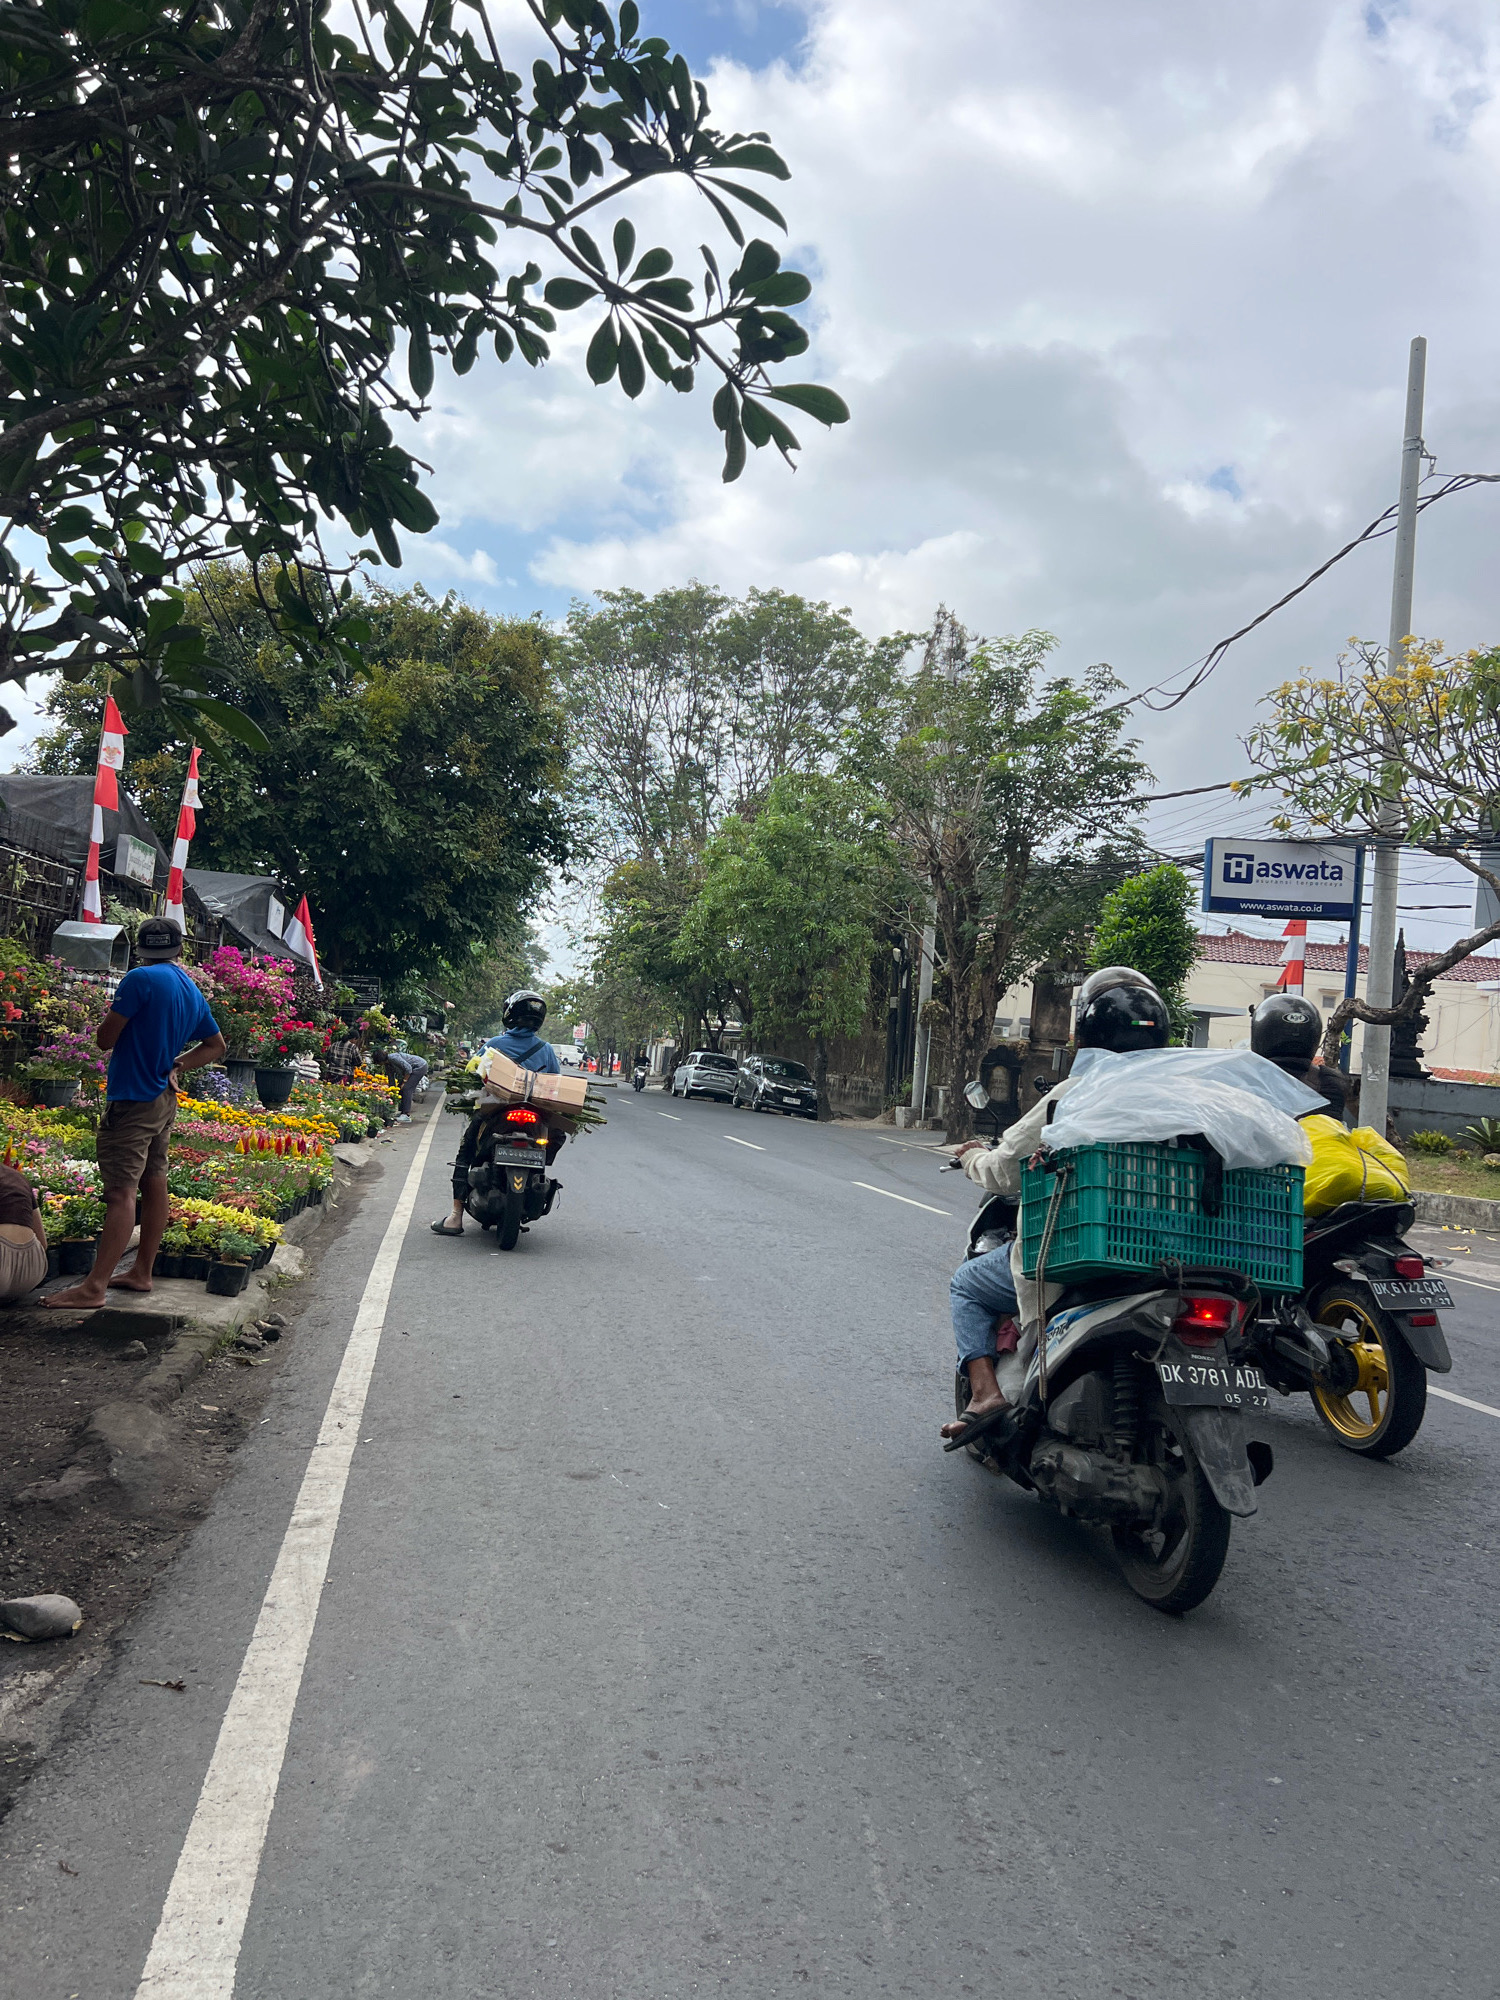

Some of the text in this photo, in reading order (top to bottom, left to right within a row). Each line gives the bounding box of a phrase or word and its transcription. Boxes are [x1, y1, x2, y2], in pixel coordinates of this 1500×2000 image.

[1256, 860, 1343, 881] aswata
[1239, 902, 1323, 913] www.aswata.co.id
[1372, 1282, 1390, 1295] DK
[1160, 1364, 1267, 1389] DK 3781 ADL
